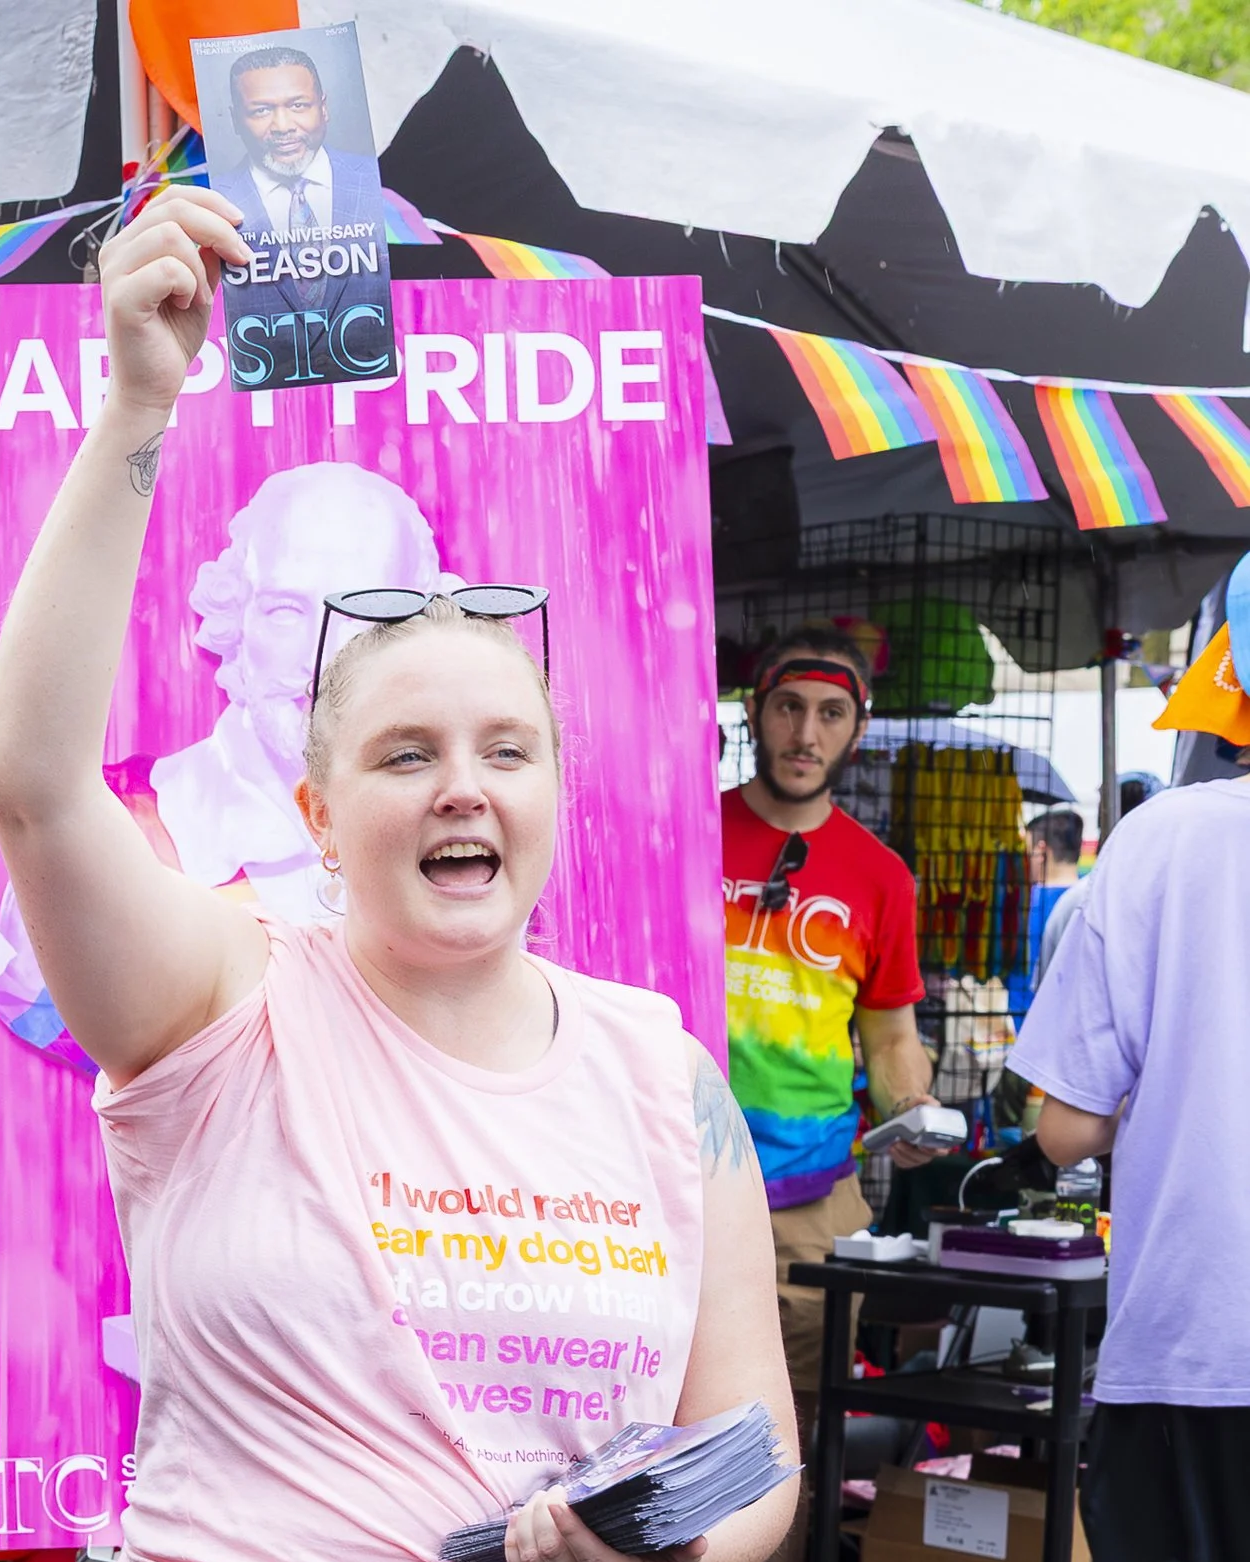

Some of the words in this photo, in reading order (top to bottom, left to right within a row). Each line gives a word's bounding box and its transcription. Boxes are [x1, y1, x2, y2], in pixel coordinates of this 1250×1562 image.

[259, 222, 376, 246] ANNIVERSARY
[225, 241, 379, 285] SEASON
[230, 303, 390, 386] STC
[401, 1184, 527, 1219] would
[533, 1191, 641, 1229] rather
[370, 1221, 433, 1258] ear
[442, 1232, 508, 1272] my
[518, 1231, 602, 1276] dog
[603, 1235, 668, 1277] bark
[393, 1267, 413, 1307] t
[419, 1276, 448, 1309] a
[456, 1278, 573, 1314] crow
[583, 1278, 659, 1324] than
[497, 1333, 629, 1371] swear
[631, 1335, 662, 1379] he
[438, 1382, 533, 1414] ves
